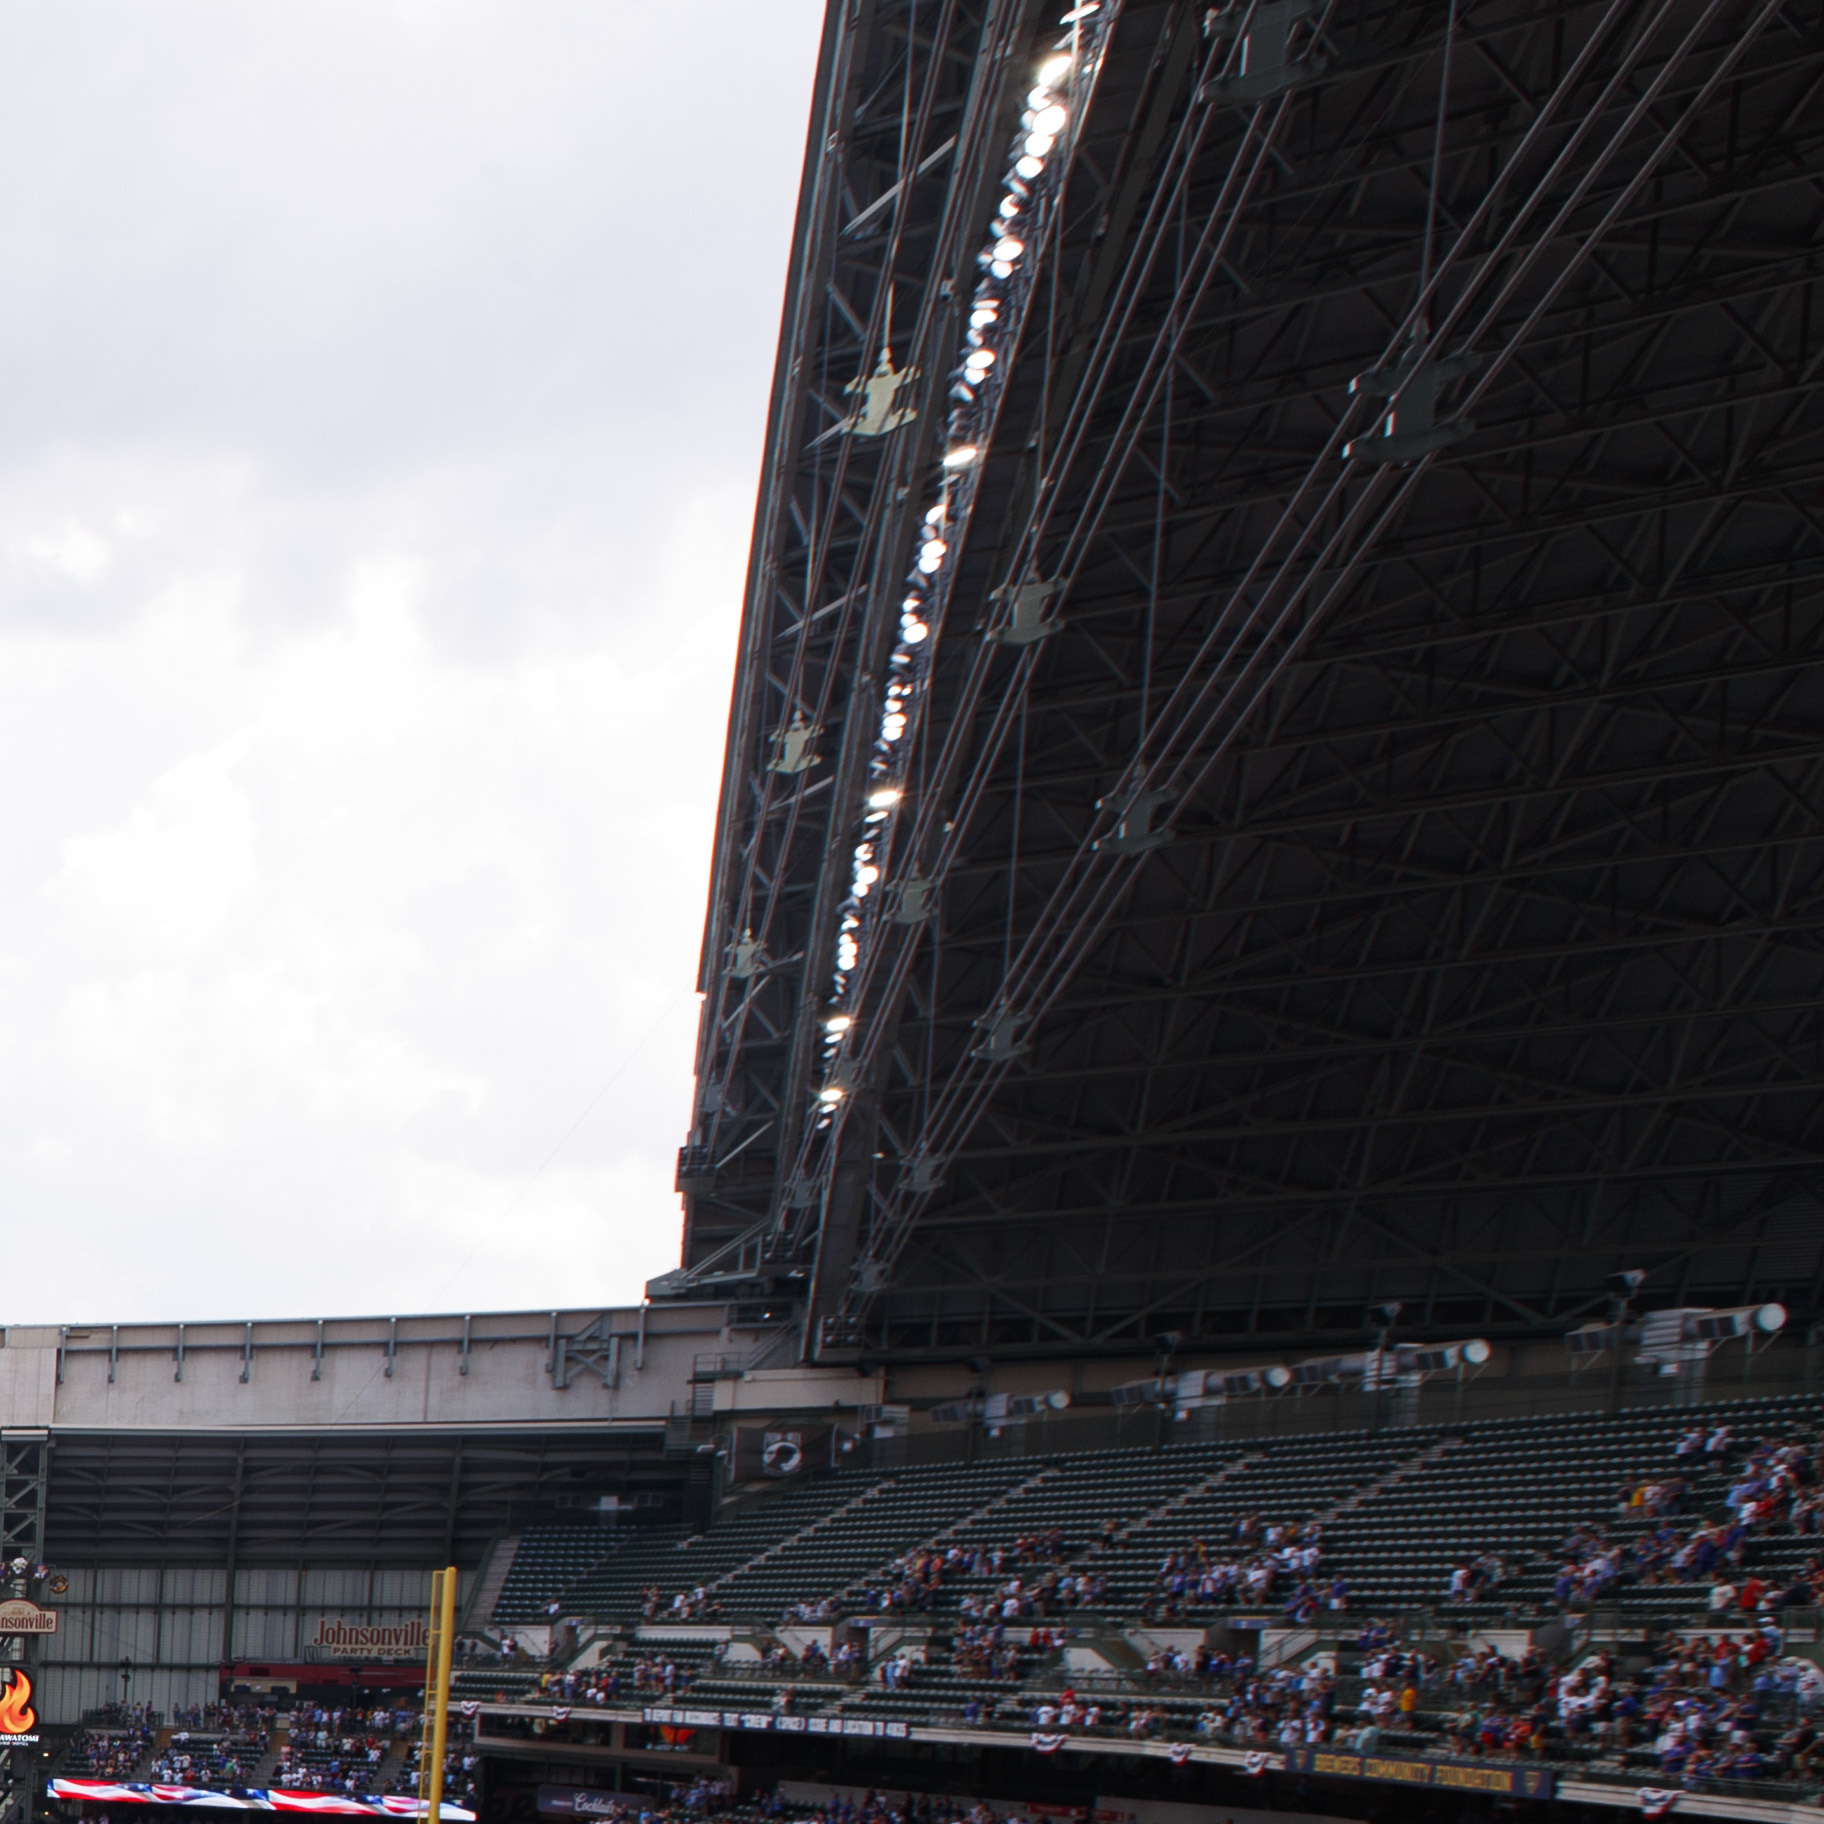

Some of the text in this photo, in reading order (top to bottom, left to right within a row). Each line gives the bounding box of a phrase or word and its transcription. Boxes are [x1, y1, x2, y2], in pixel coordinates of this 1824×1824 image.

[314, 1619, 430, 1646] Johnsonville
[333, 1647, 412, 1656] PARTY DECK
